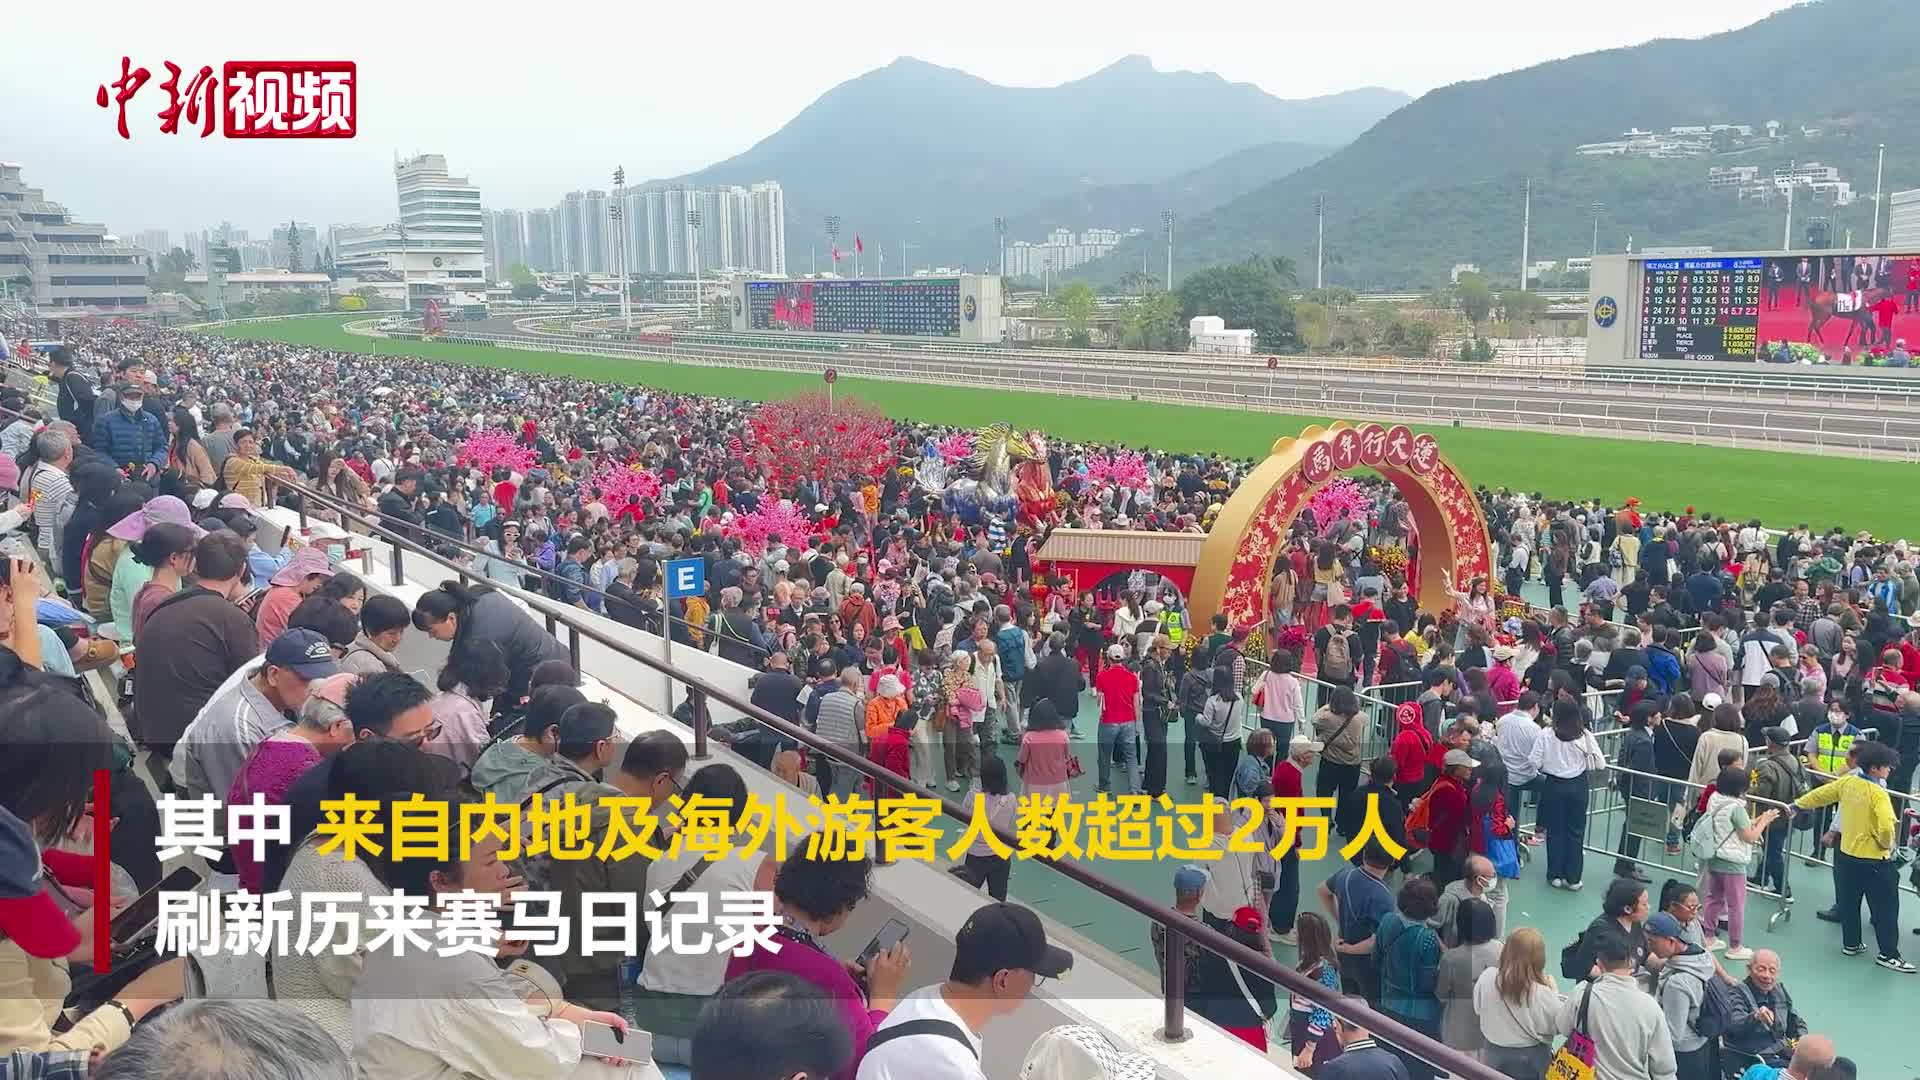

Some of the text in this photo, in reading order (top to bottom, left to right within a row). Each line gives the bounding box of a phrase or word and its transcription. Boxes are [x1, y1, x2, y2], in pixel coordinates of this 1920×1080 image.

[1309, 431, 1437, 476] 馬年行大運
[678, 566, 695, 590] E
